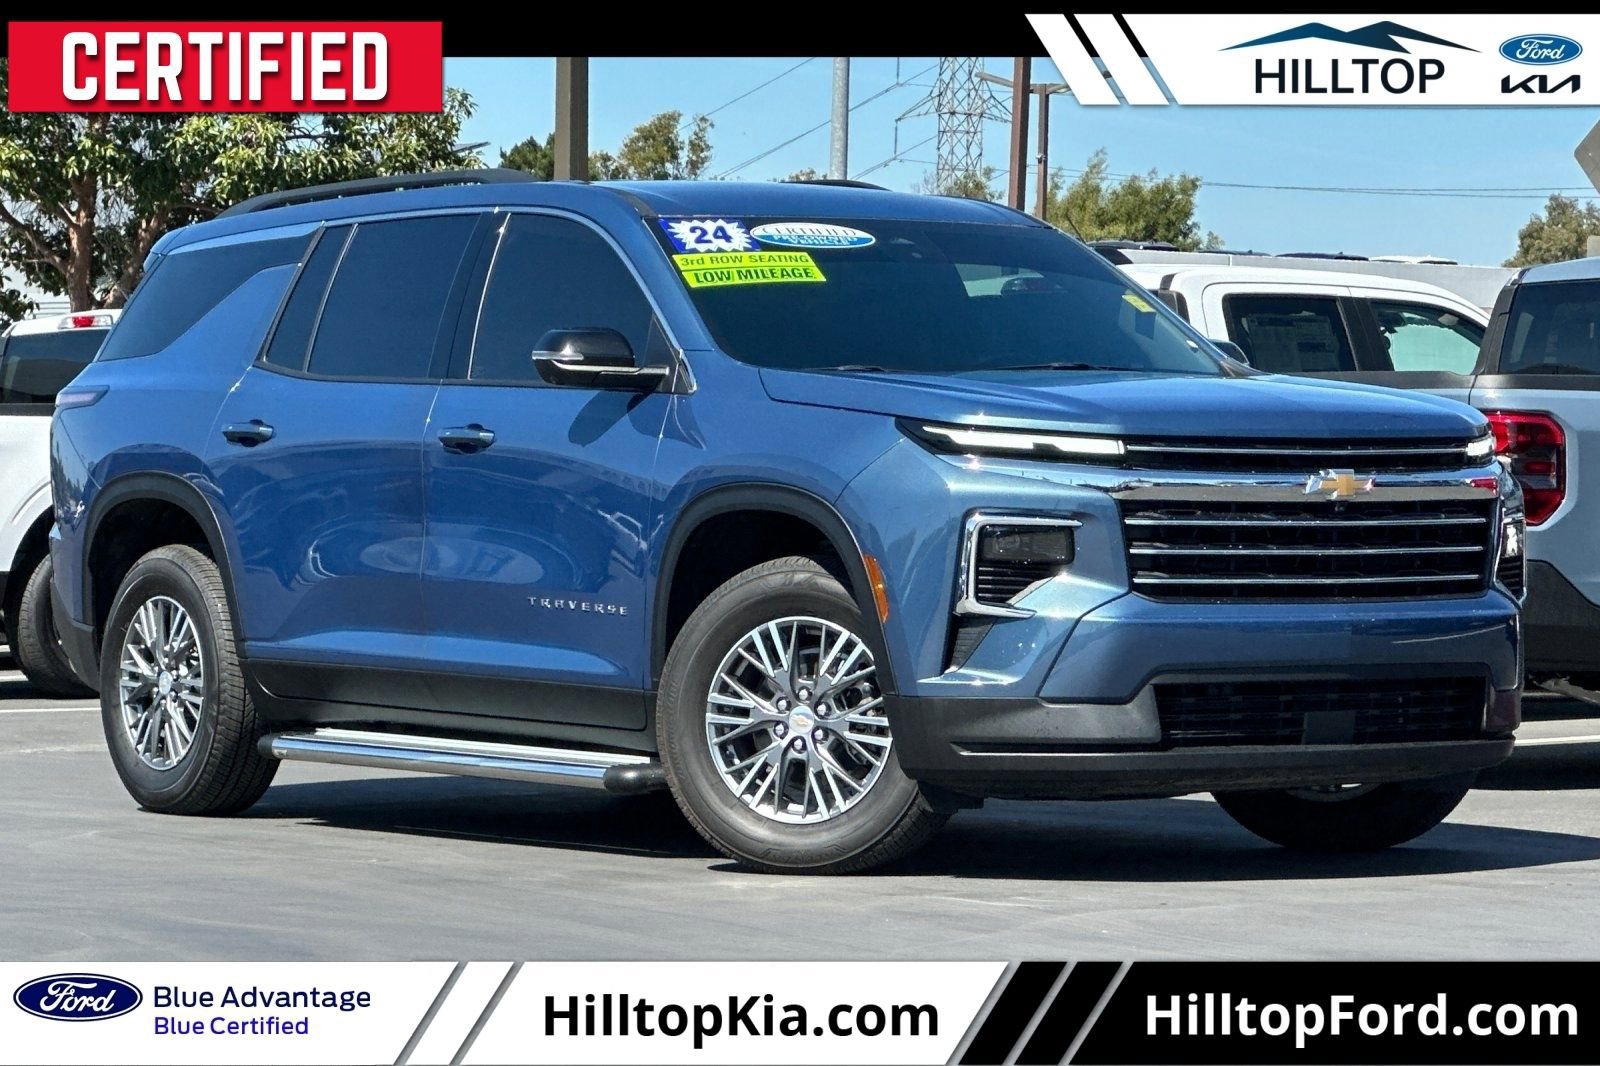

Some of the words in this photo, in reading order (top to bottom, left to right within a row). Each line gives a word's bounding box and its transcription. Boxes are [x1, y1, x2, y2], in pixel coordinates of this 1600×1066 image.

[690, 225, 733, 244] 24
[681, 256, 705, 267] 3rd
[710, 254, 743, 265] ROW
[748, 253, 810, 264] SEATING
[694, 270, 732, 284] LOW
[736, 266, 815, 281] MILEAGE
[527, 596, 629, 616] TRAVERSE
